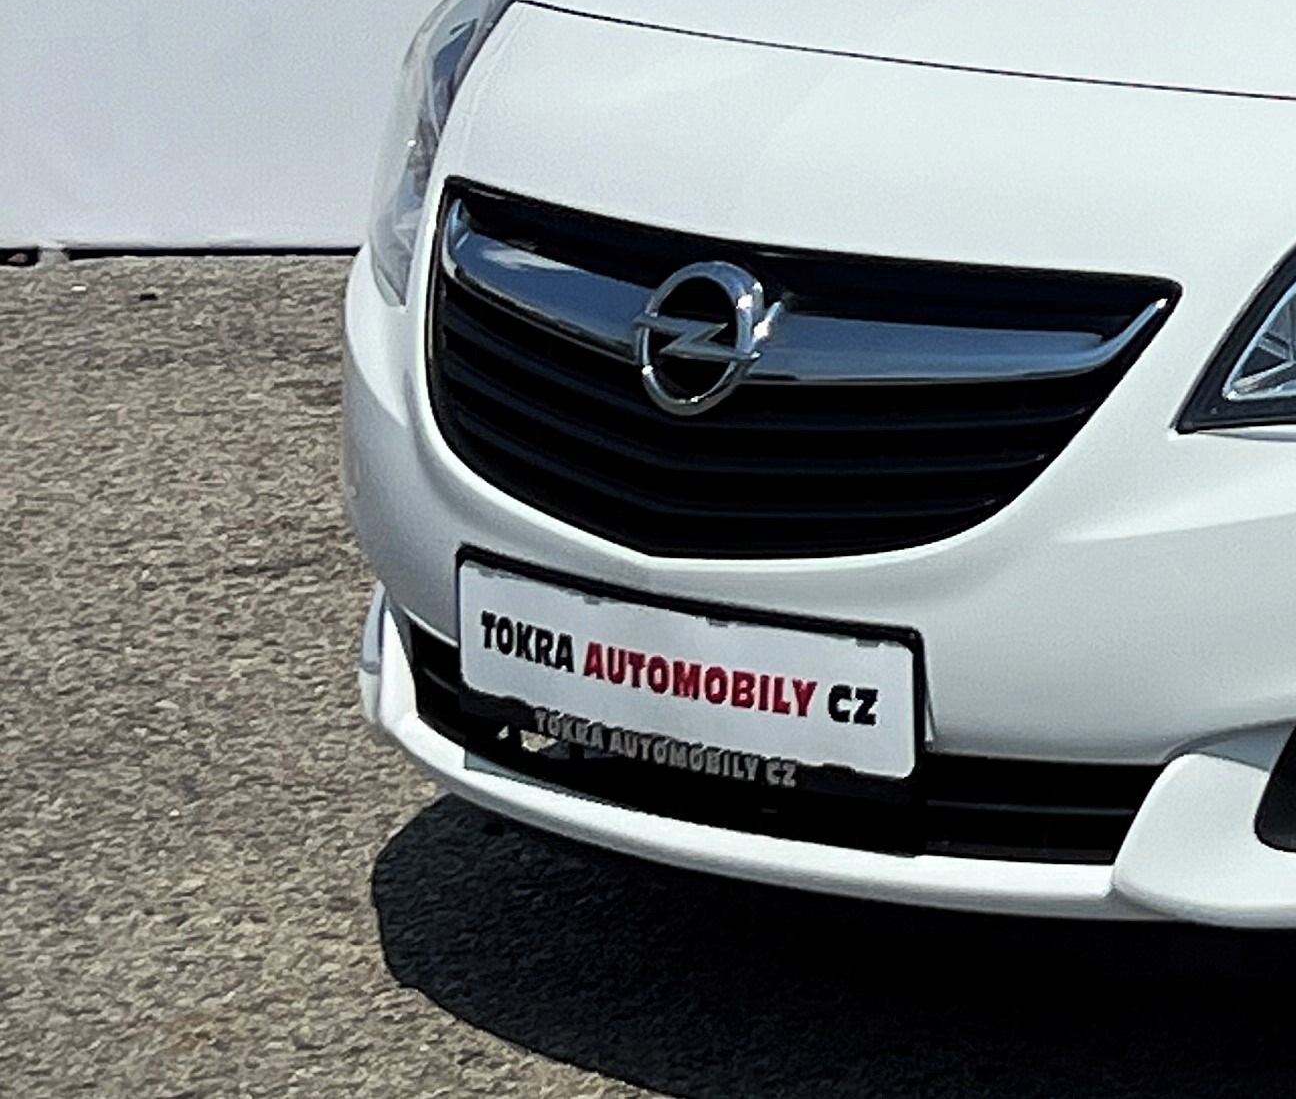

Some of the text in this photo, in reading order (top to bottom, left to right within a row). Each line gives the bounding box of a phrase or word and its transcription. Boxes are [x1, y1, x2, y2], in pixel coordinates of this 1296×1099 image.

[480, 610, 880, 727] TOKRA AUTOMOBILY CZ
[534, 708, 797, 788] TOKRA AUTOMOBILY CZ
